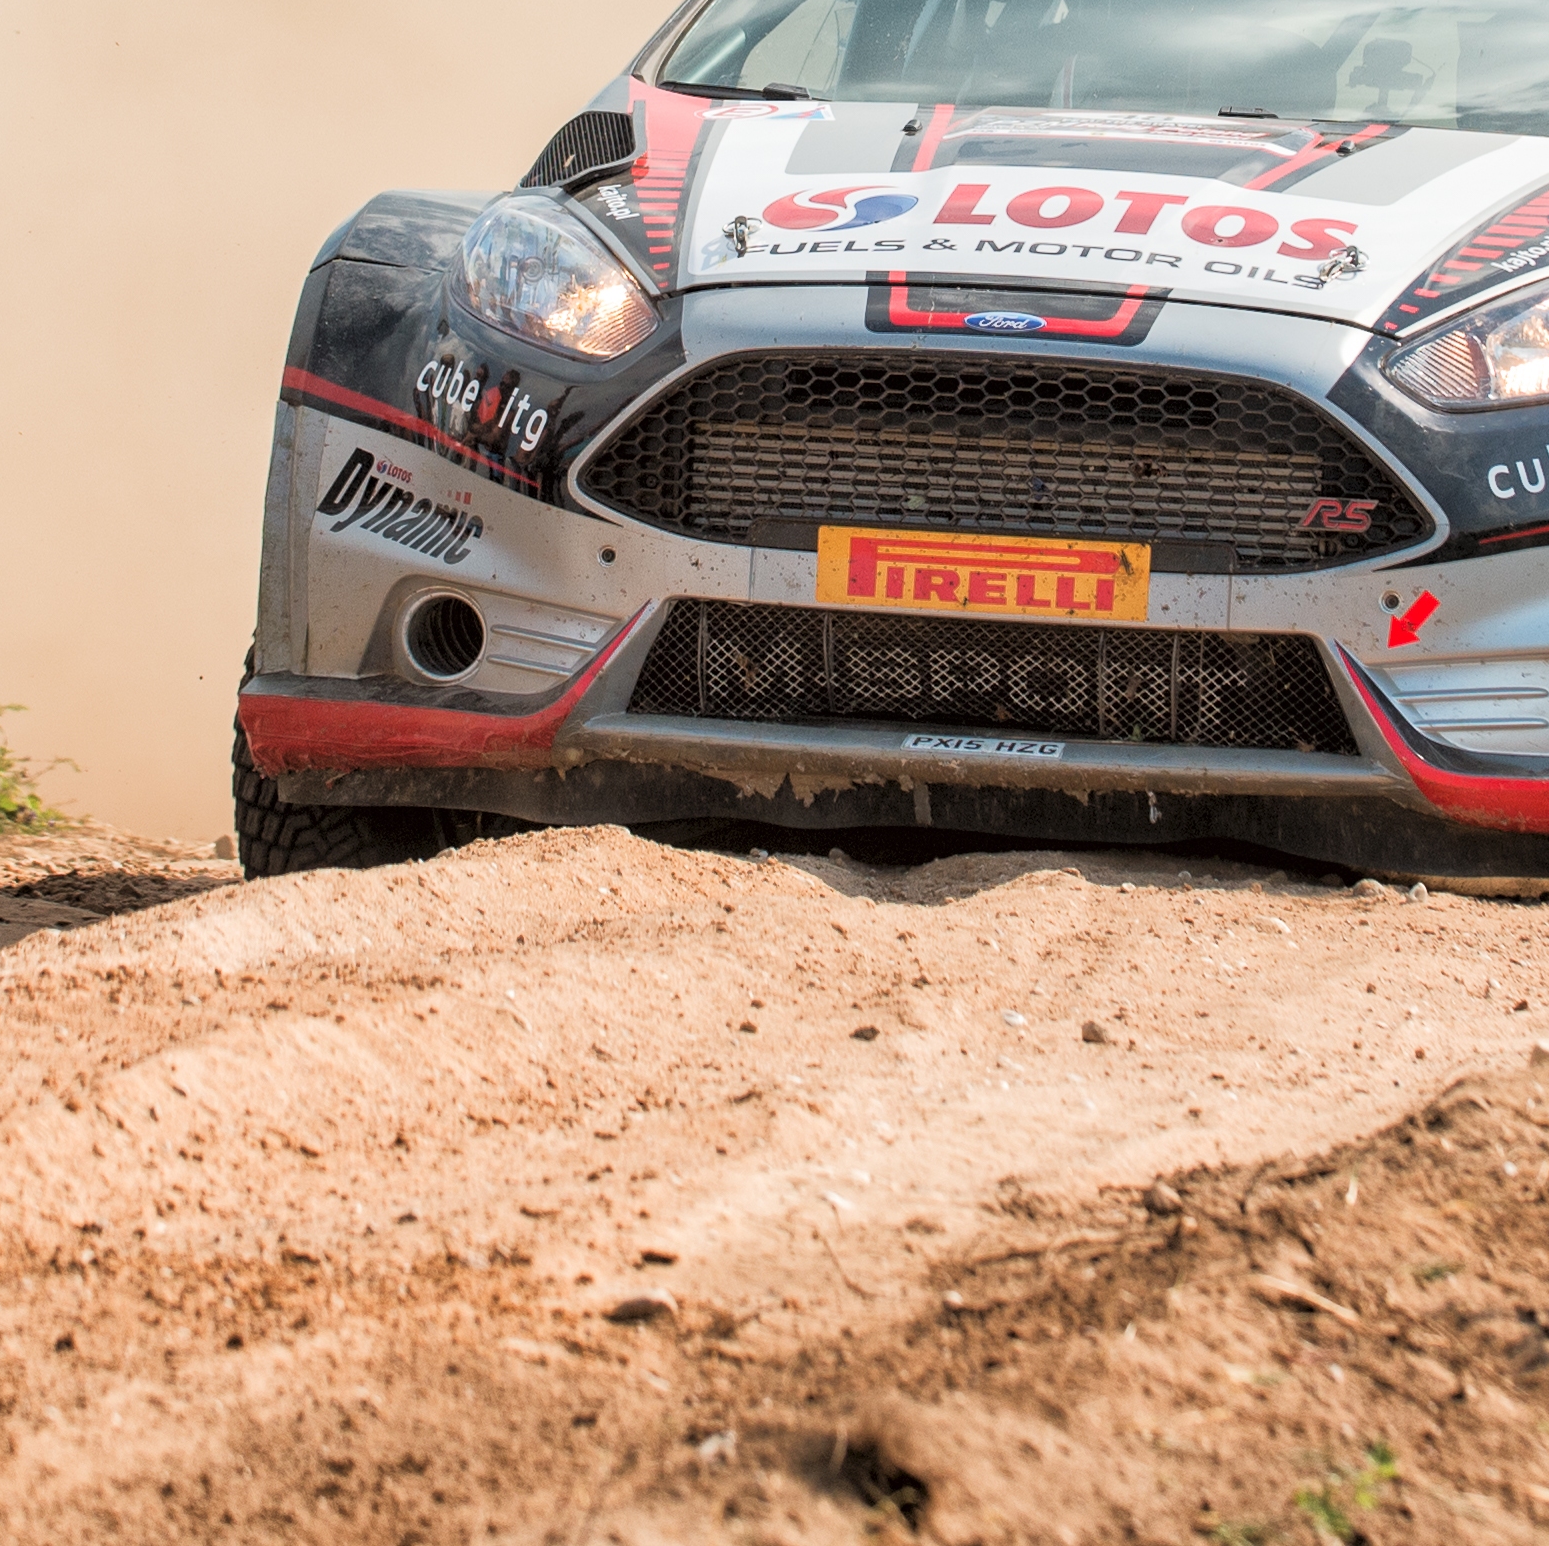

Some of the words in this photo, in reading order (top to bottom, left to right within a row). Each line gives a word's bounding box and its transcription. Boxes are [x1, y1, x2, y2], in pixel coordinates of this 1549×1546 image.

[596, 184, 641, 221] kajto.pl
[932, 183, 1359, 262] LOTOS
[742, 239, 906, 255] FUELS
[922, 238, 958, 252] &
[974, 239, 1183, 269] MOTOR
[1204, 260, 1328, 291] OILS
[978, 313, 1031, 329] Ford
[416, 360, 480, 412] cube
[497, 386, 549, 452] itg
[386, 463, 414, 484] LOTOS
[316, 447, 484, 565] Dynamic
[1299, 497, 1380, 533] RS
[846, 536, 1121, 612] PIRELLI
[911, 736, 985, 750] PX15
[995, 741, 1059, 755] HZG
